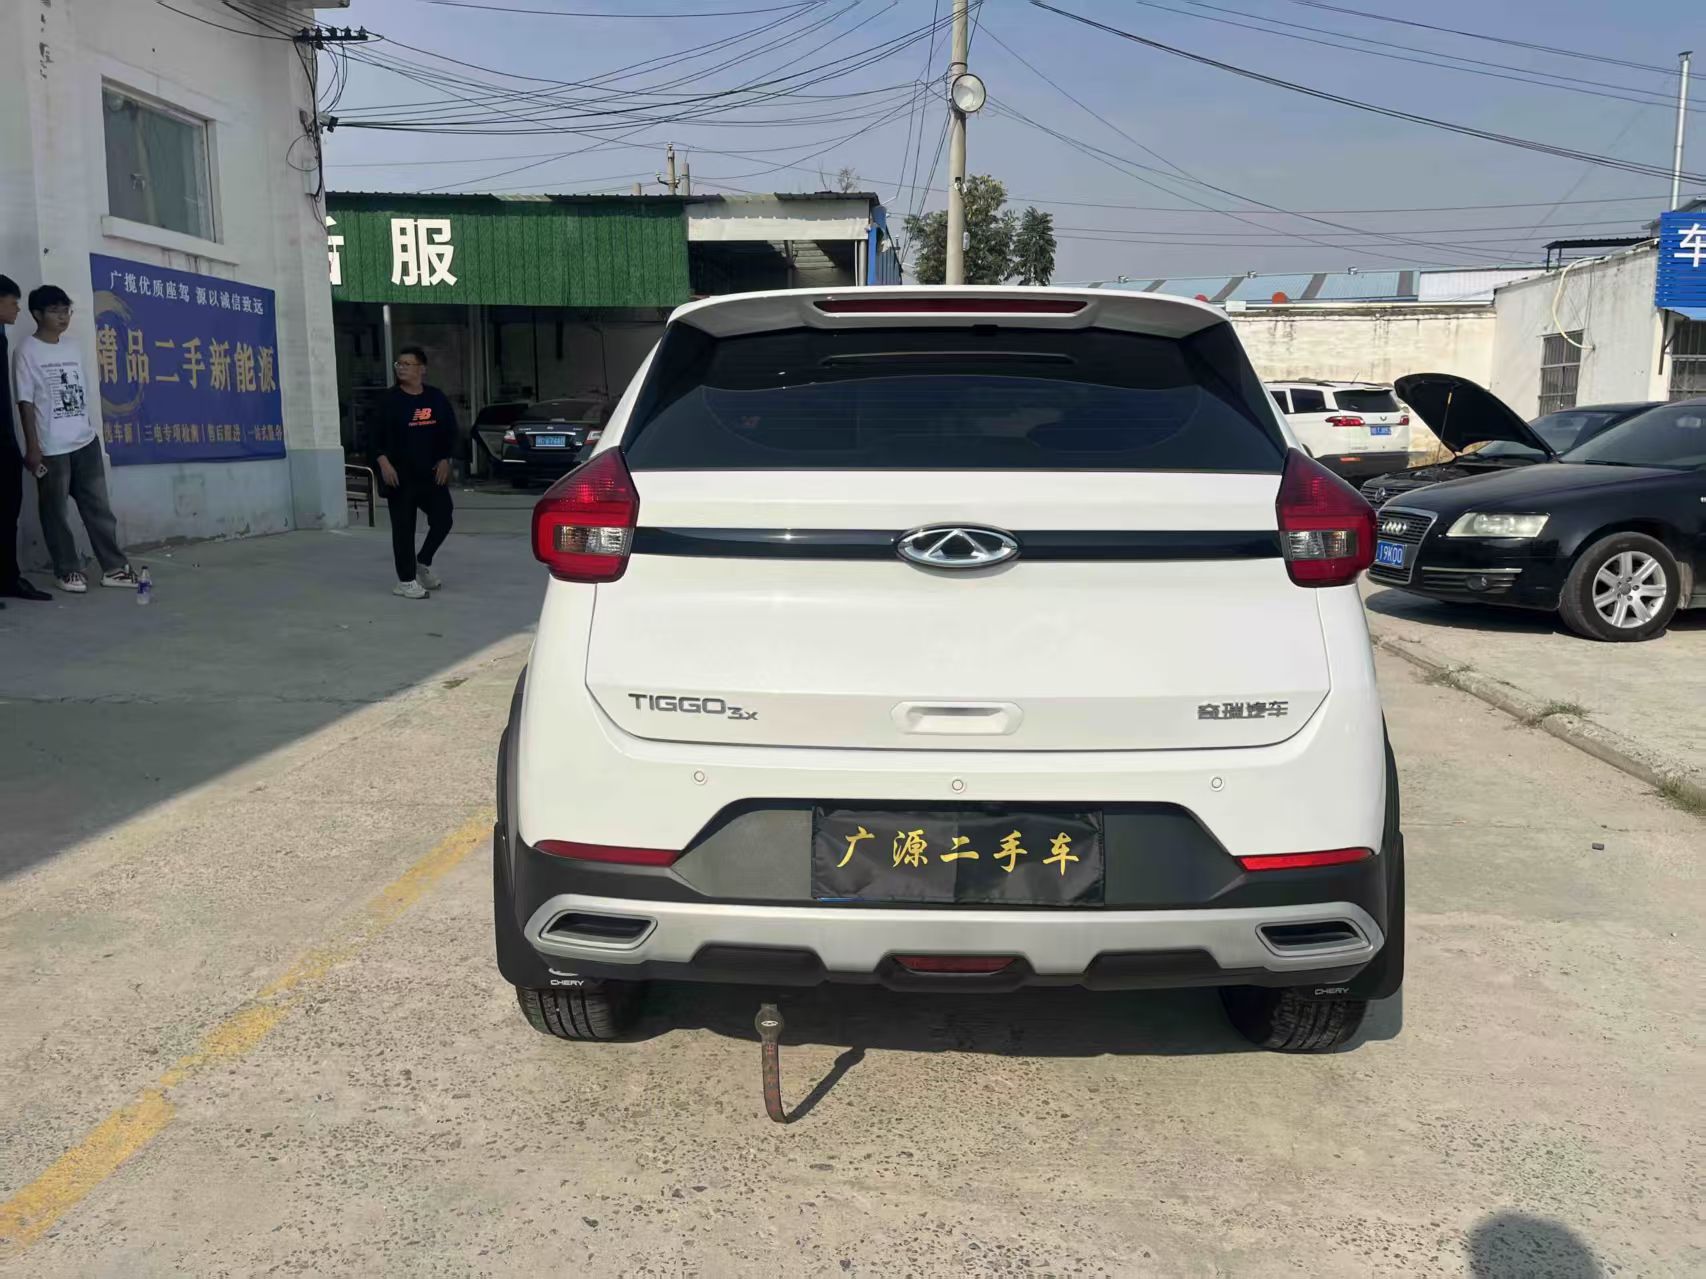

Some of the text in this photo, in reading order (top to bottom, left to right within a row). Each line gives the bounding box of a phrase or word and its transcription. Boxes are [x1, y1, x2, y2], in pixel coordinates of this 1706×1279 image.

[1674, 223, 1706, 267] 车
[110, 270, 264, 315] 广揽优质座驾 源以诚信致远
[96, 323, 276, 392] 精品二手新能源
[628, 693, 726, 714] TIGGO
[1198, 701, 1288, 720] 奇瑞汽车
[836, 826, 1080, 876] 广源二手车
[1314, 987, 1350, 996] CHERY
